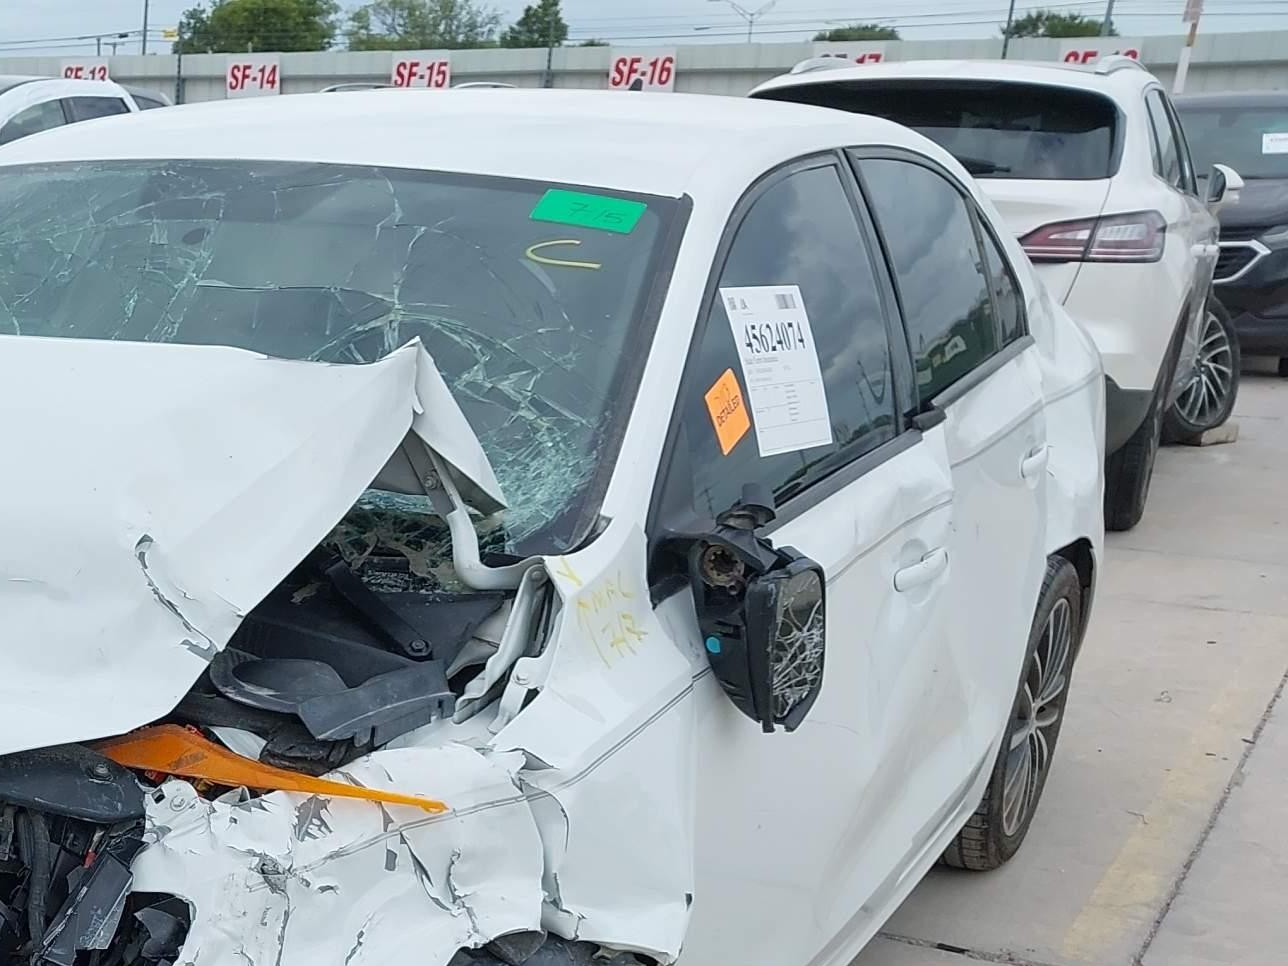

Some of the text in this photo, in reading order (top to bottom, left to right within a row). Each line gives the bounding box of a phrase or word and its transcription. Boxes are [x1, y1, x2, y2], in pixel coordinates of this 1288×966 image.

[228, 64, 278, 91] SF-14
[393, 61, 449, 88] SF-15
[612, 57, 674, 87] SF-16
[744, 320, 806, 354] 45624074
